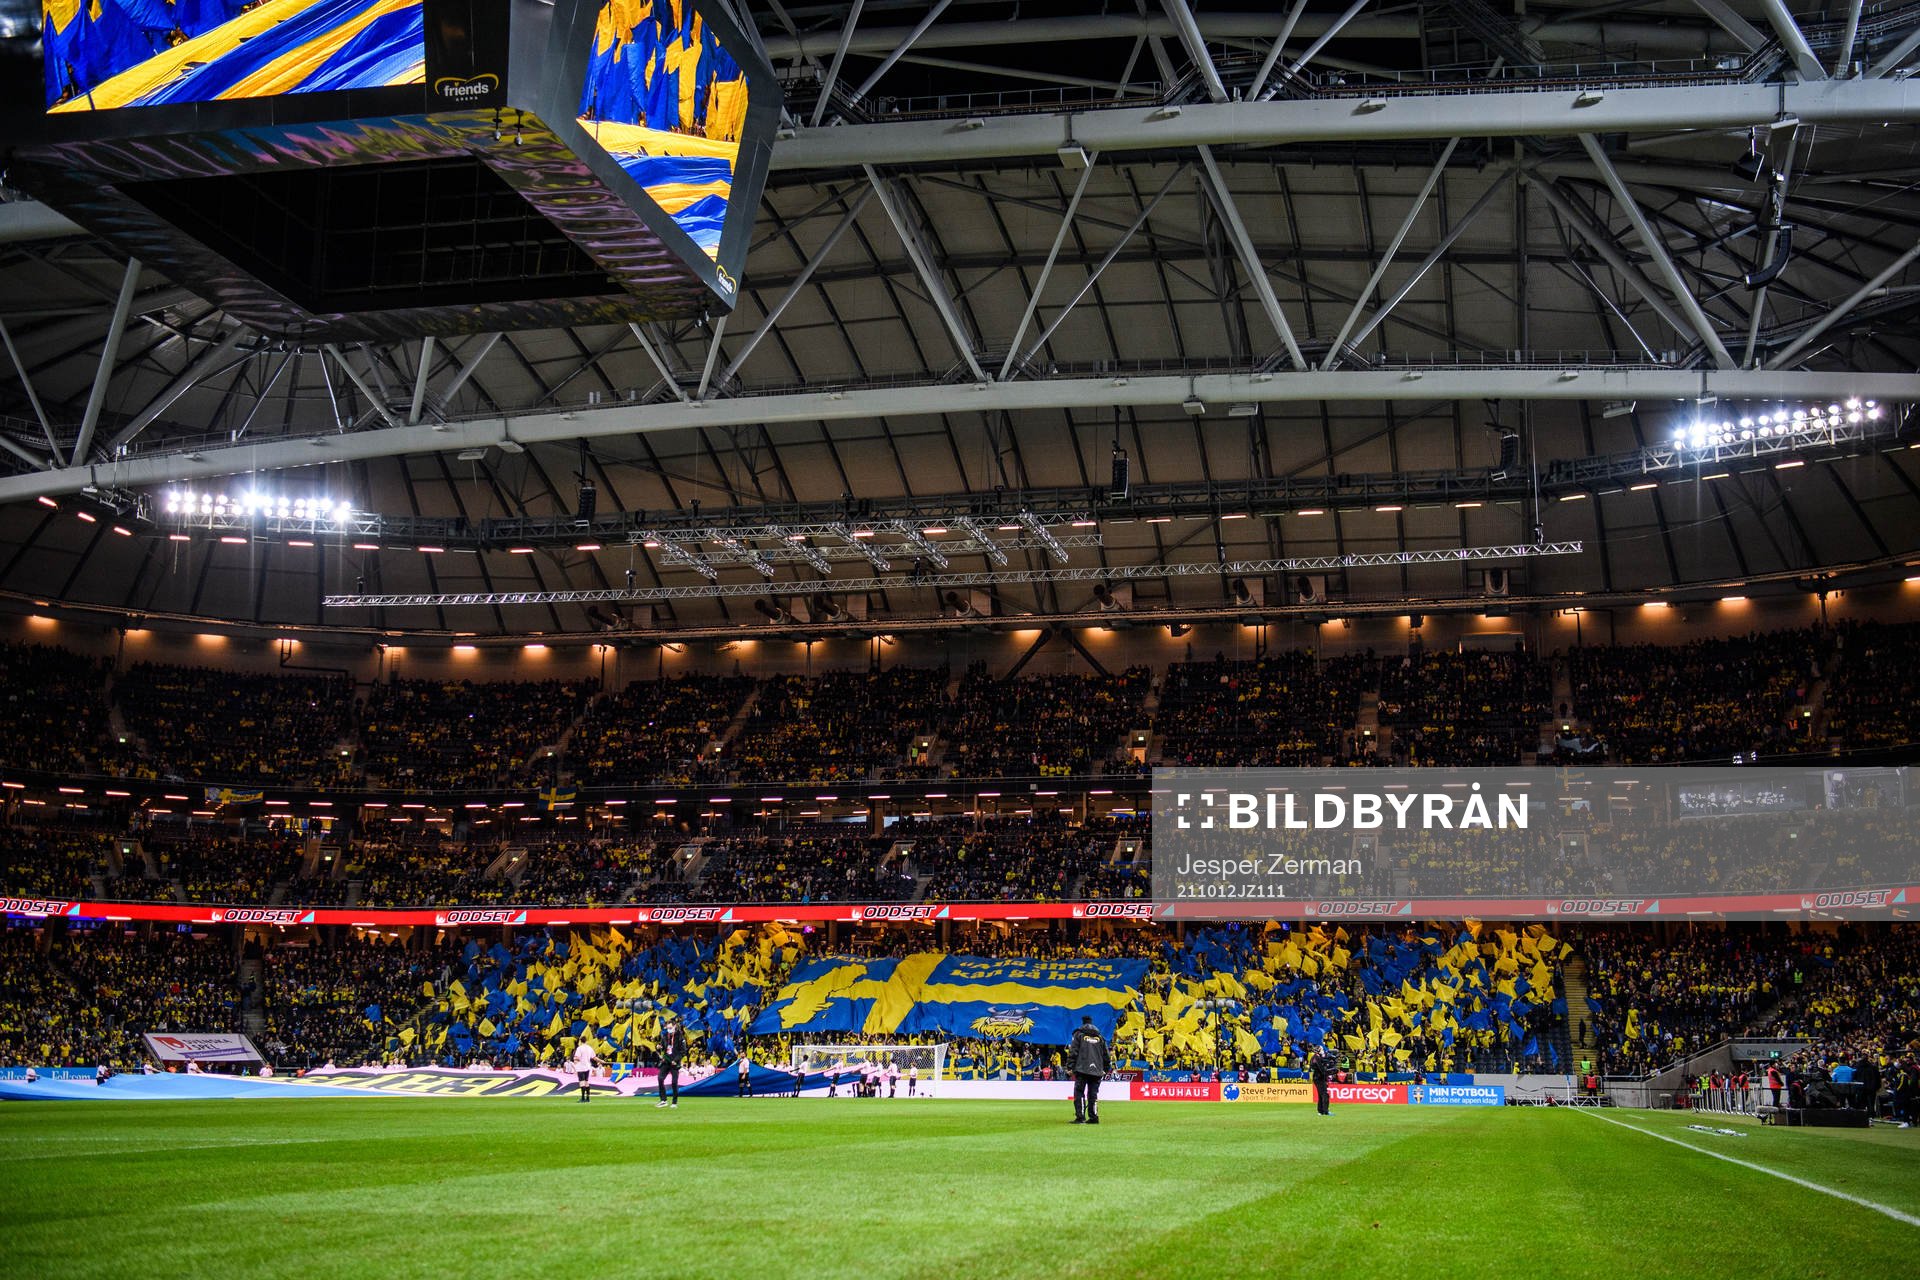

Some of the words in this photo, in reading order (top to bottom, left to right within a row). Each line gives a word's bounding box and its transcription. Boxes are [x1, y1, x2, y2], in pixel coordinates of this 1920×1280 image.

[444, 82, 489, 97] friends
[1815, 889, 1891, 909] ODDSET
[864, 905, 936, 919] ODDSET
[1085, 903, 1161, 917] ODDSET
[1318, 901, 1397, 915] ODDSET
[1560, 899, 1645, 914] ODDSET
[224, 908, 302, 923] ODDSET
[448, 910, 515, 924] ODDSET
[650, 907, 720, 921] ODDSET
[1152, 1087, 1209, 1097] BAUHAUS
[1241, 1087, 1264, 1095] Steve
[1267, 1087, 1308, 1096] Perryman
[1429, 1088, 1449, 1096] MIN
[1450, 1088, 1498, 1097] FOTBOLL
